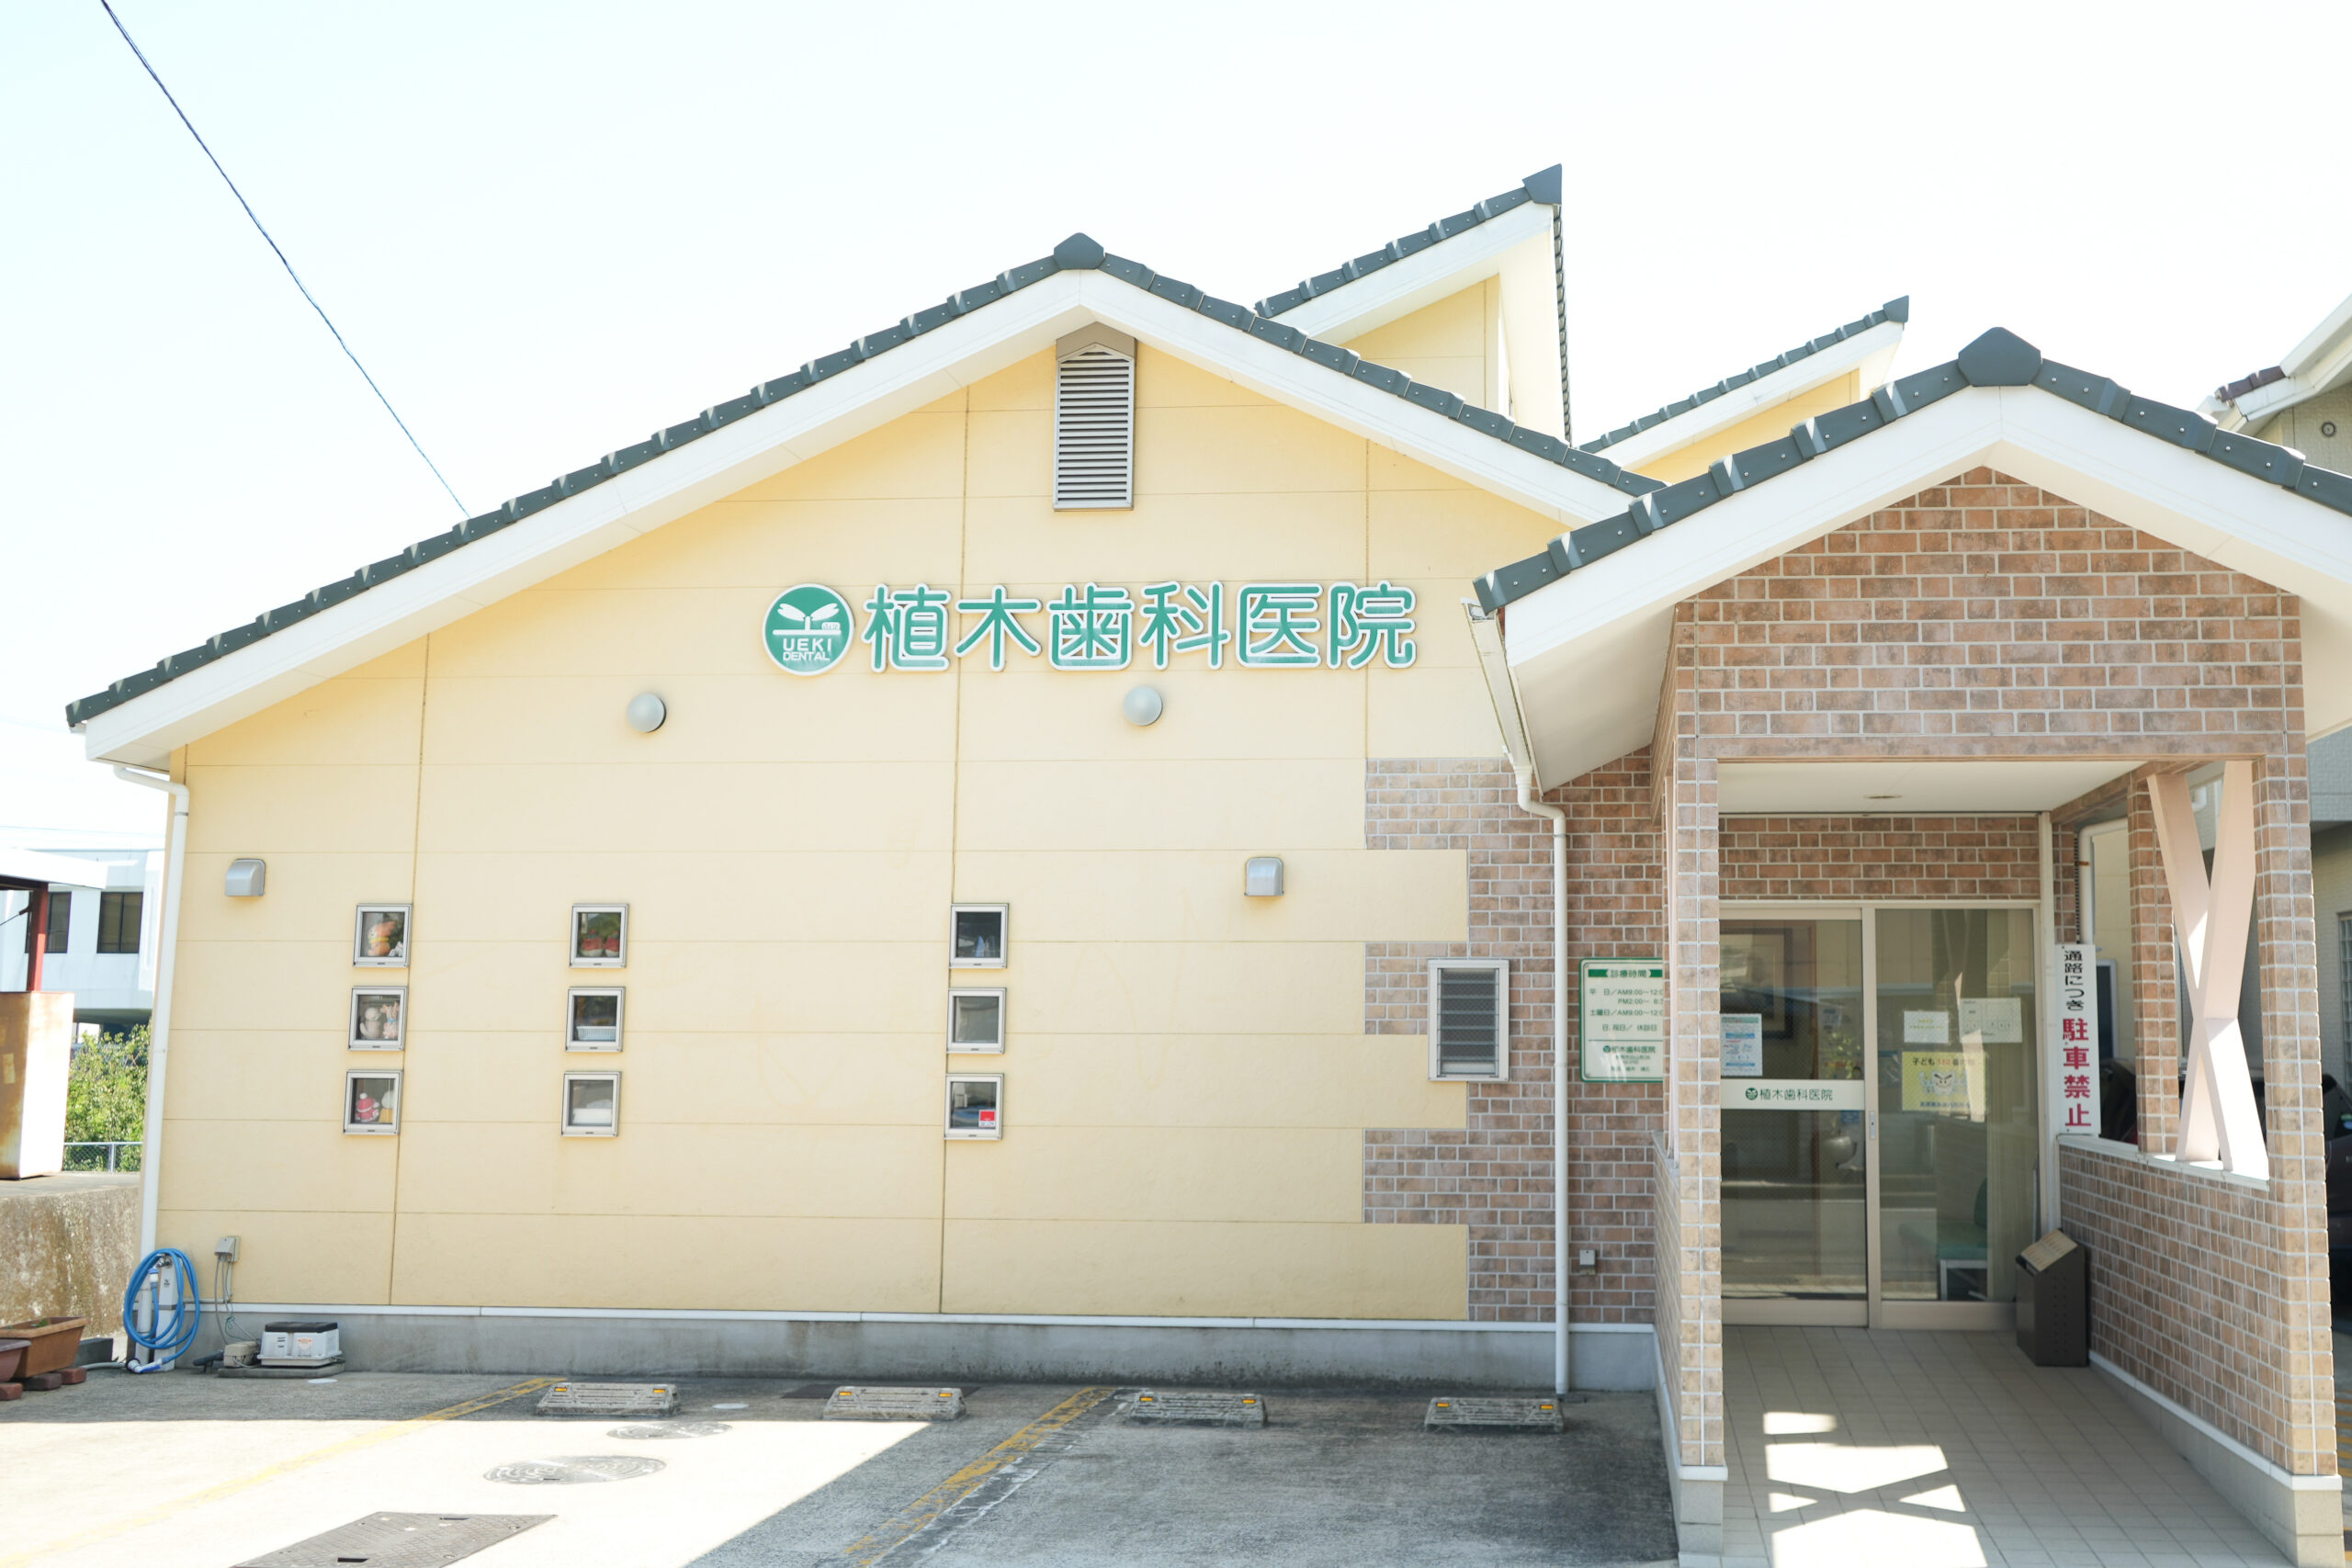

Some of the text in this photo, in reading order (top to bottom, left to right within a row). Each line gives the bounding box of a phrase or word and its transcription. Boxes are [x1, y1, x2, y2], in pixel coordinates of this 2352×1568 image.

[861, 580, 1417, 673] 植木歯科医院
[783, 637, 832, 652] UEKI
[782, 651, 831, 661] DENTAL
[1611, 969, 1646, 977] 診療時間
[2063, 950, 2092, 1127] 通路につき 駐車禁止
[1912, 1057, 1935, 1066] 子ども
[1759, 1089, 1834, 1101] 植木歯科医院
